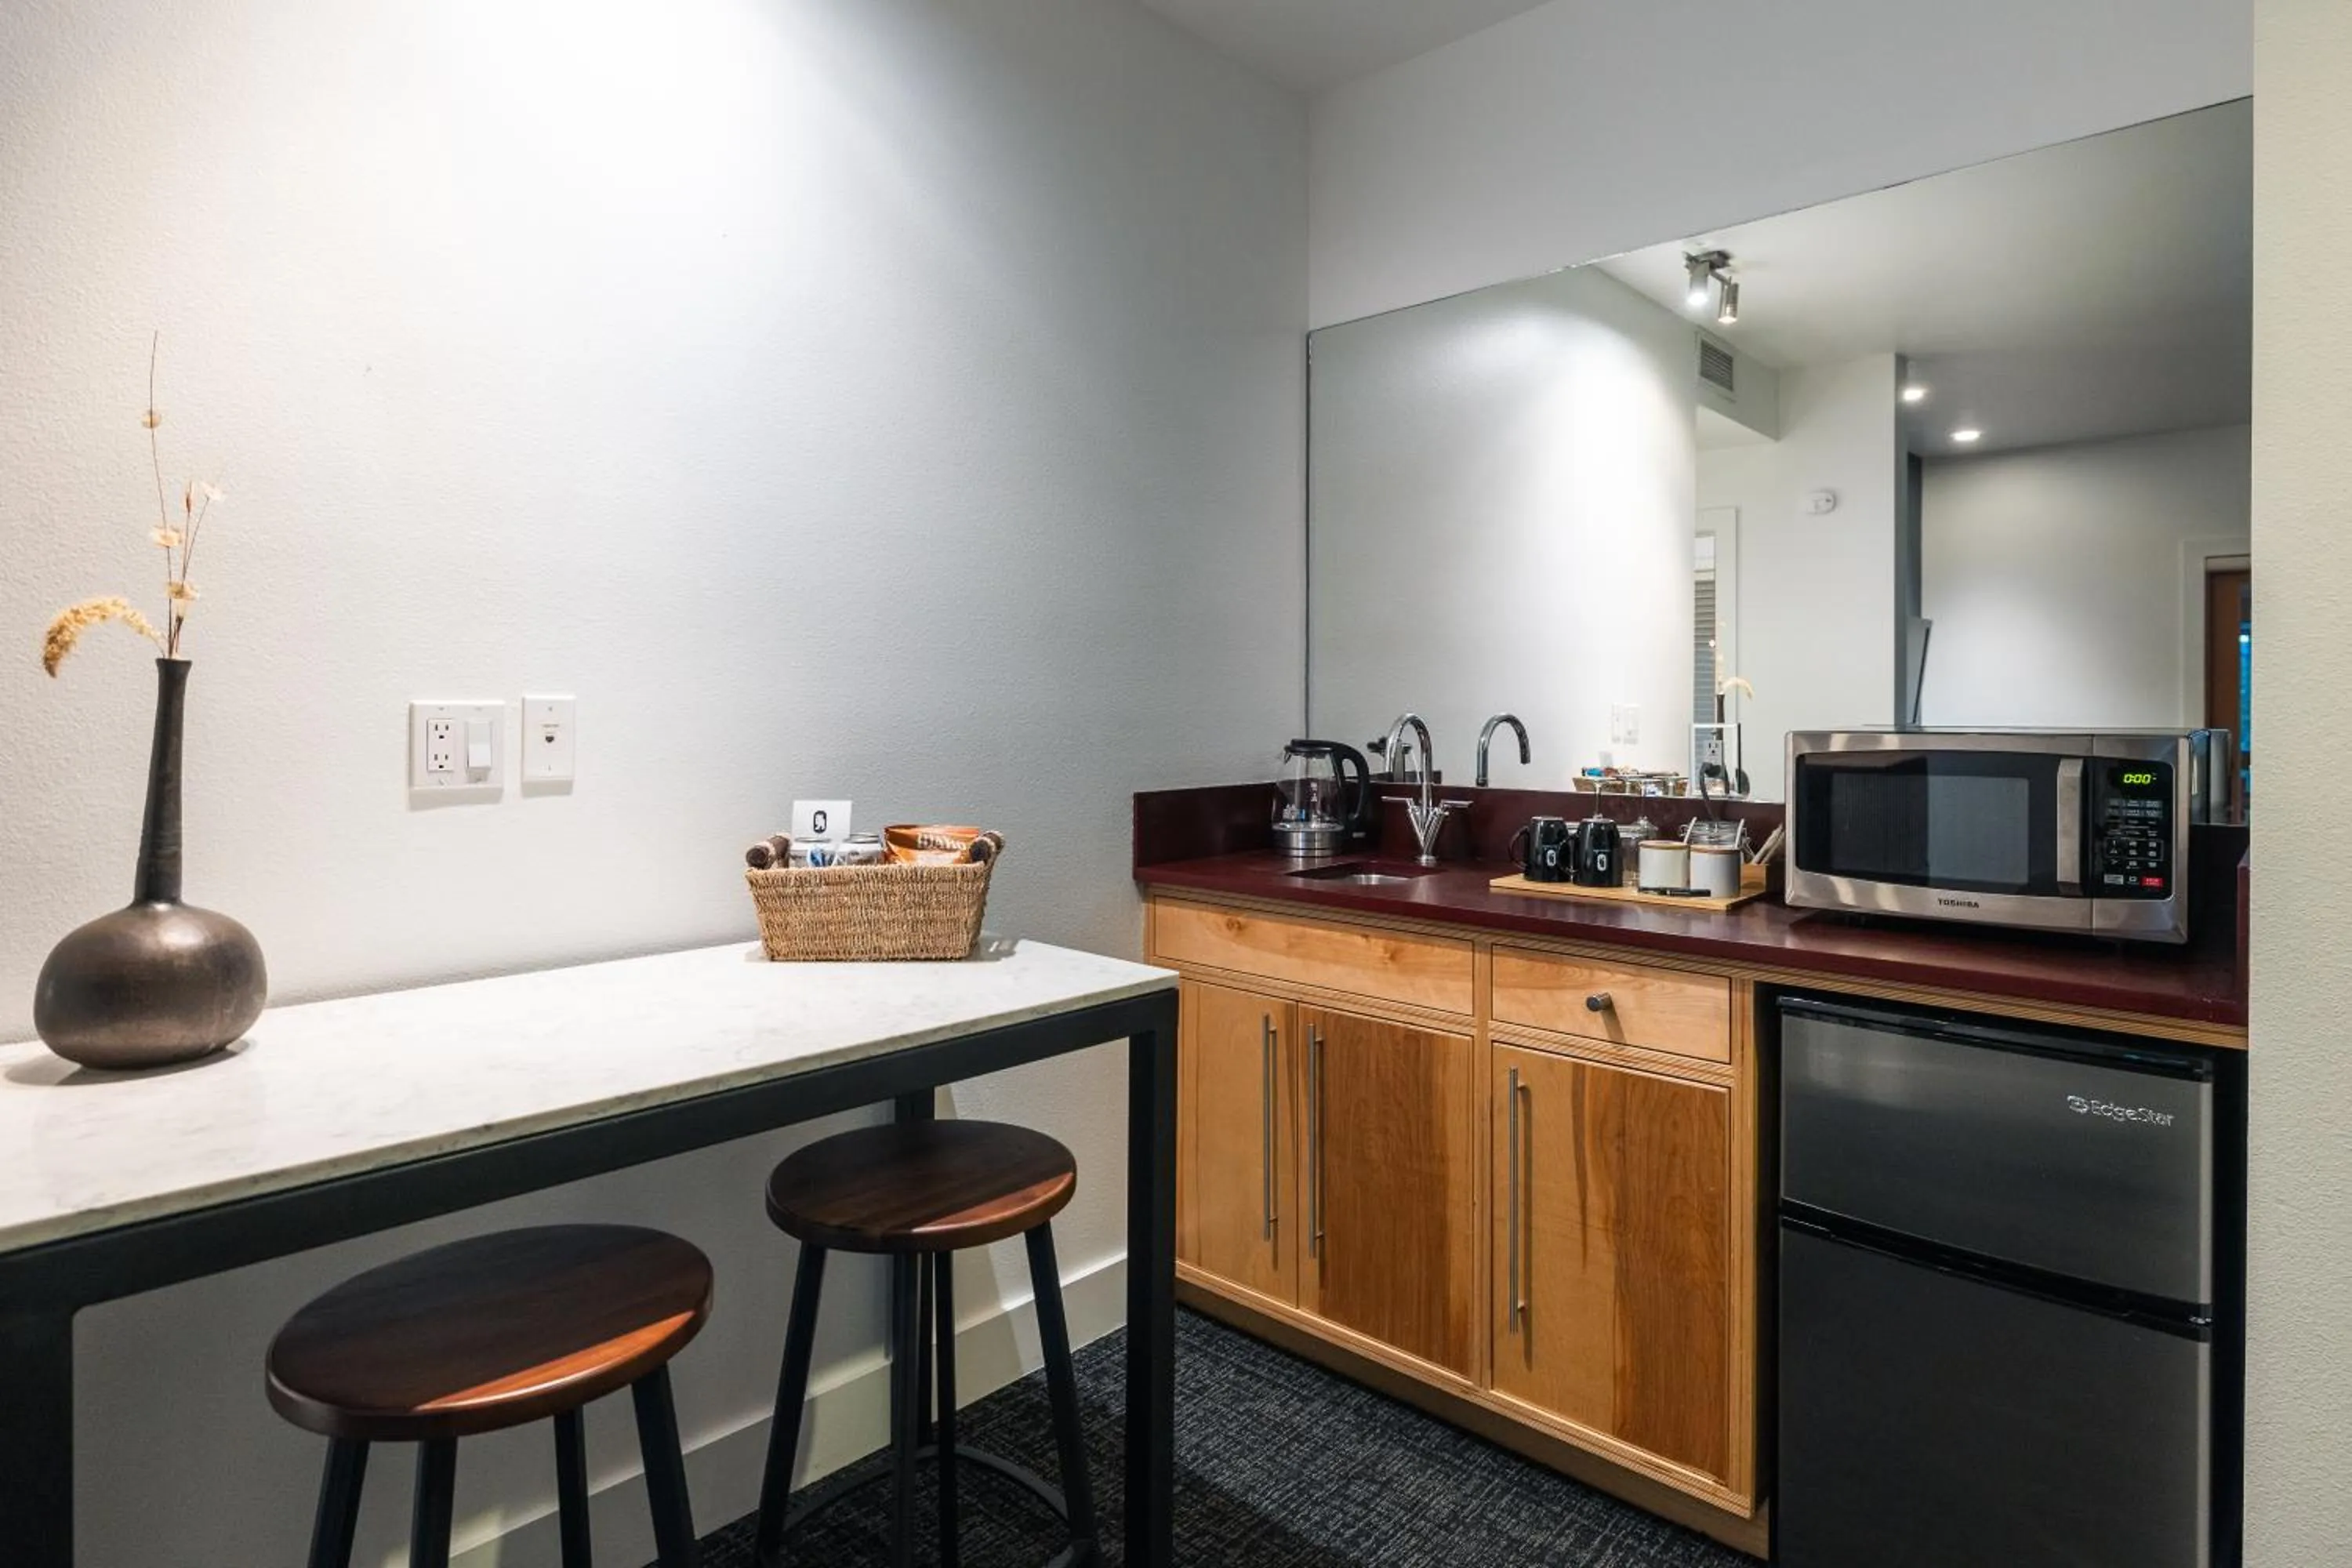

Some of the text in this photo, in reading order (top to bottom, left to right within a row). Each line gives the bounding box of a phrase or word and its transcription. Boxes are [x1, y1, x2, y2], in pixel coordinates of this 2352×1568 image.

[2123, 774, 2151, 784] 0:00
[1937, 898, 1980, 909] TOSHIBA
[2090, 1099, 2176, 1127] EdgeStar
